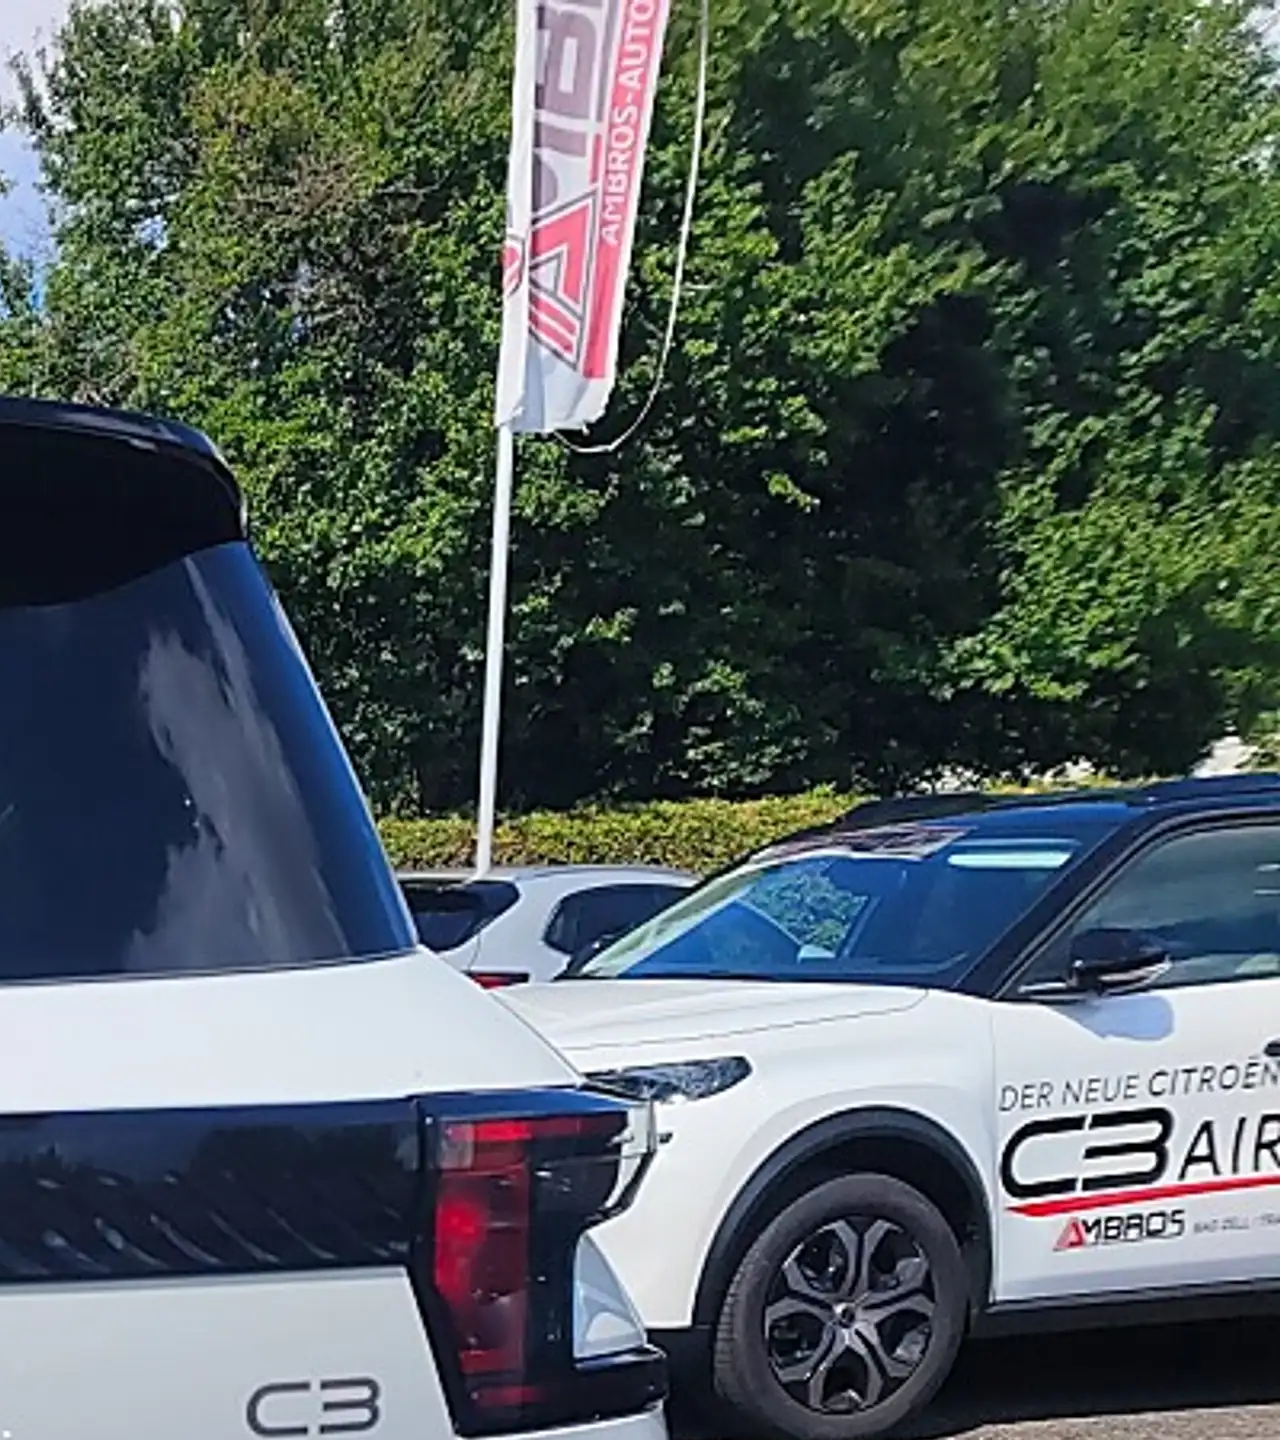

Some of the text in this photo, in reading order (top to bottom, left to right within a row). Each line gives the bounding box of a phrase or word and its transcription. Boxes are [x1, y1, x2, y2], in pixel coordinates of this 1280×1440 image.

[999, 1081, 1054, 1112] DER
[1061, 1073, 1141, 1105] NEUE
[999, 1106, 1175, 1198] C3
[1052, 1208, 1185, 1251] AMBROS
[245, 1377, 380, 1438] C3
